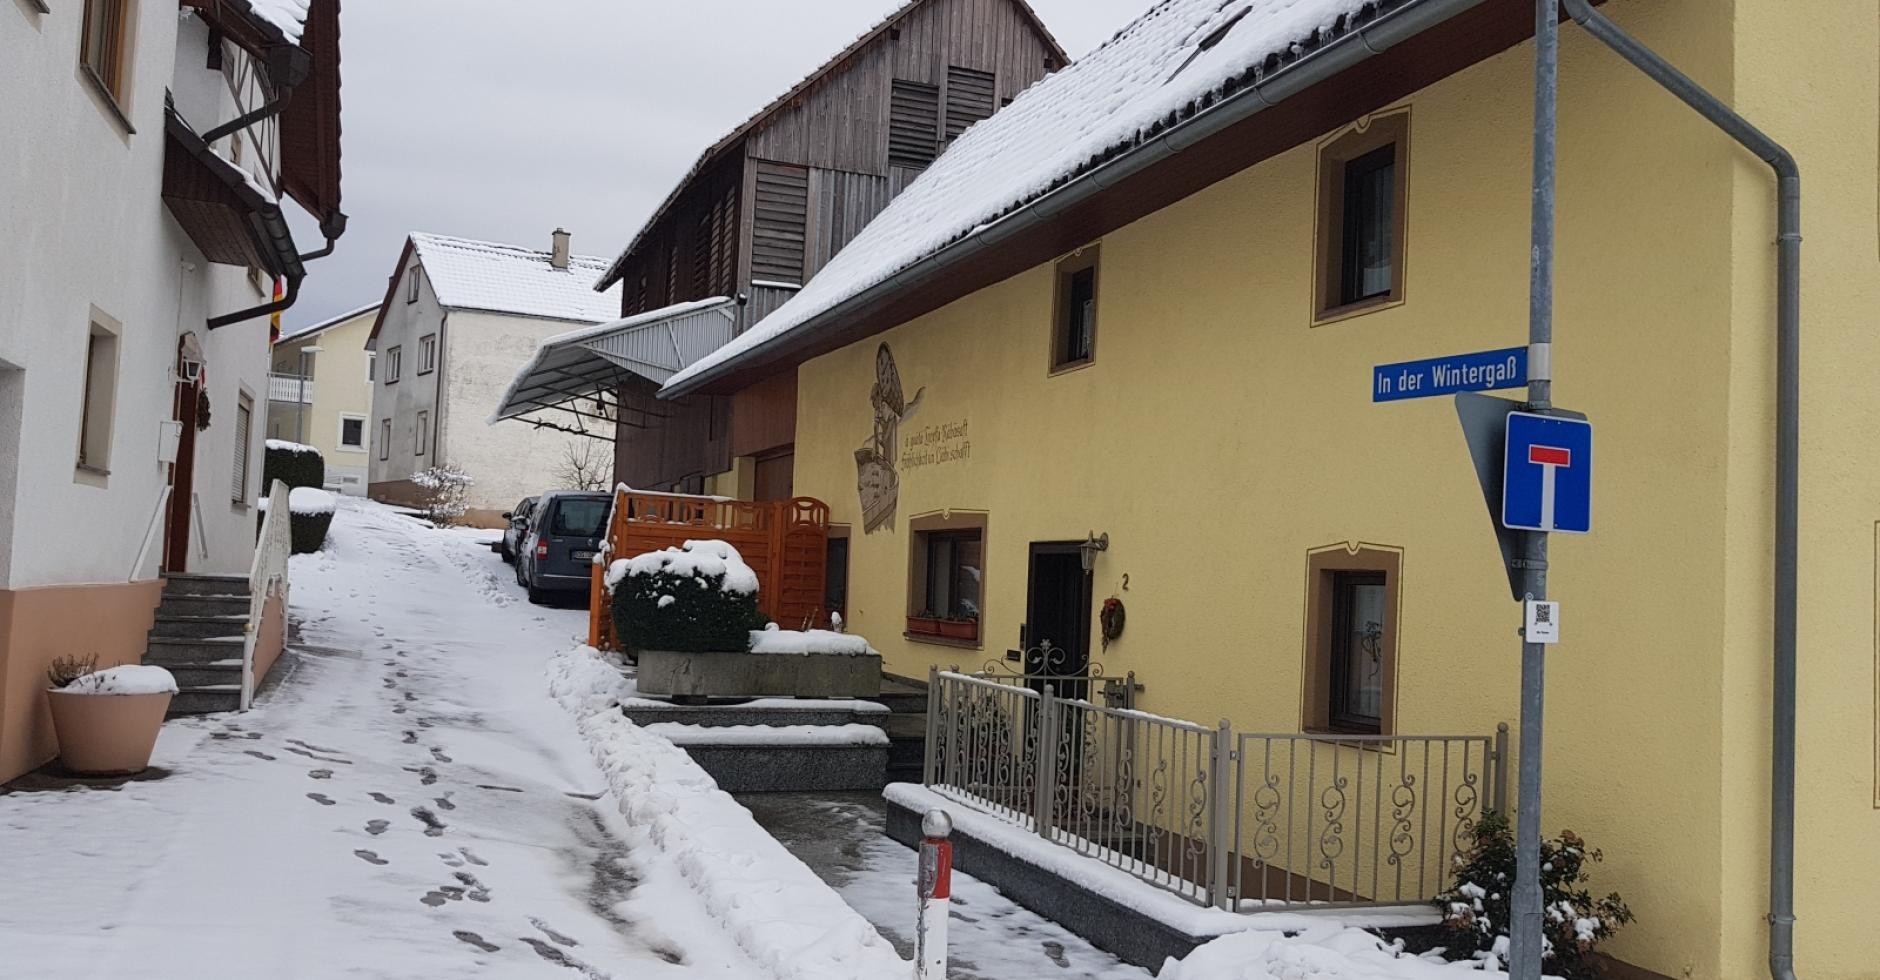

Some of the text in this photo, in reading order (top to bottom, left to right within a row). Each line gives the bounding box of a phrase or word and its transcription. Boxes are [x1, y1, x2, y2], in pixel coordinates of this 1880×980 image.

[1377, 355, 1516, 394] In der Wintergaß
[1122, 573, 1129, 591] 2
